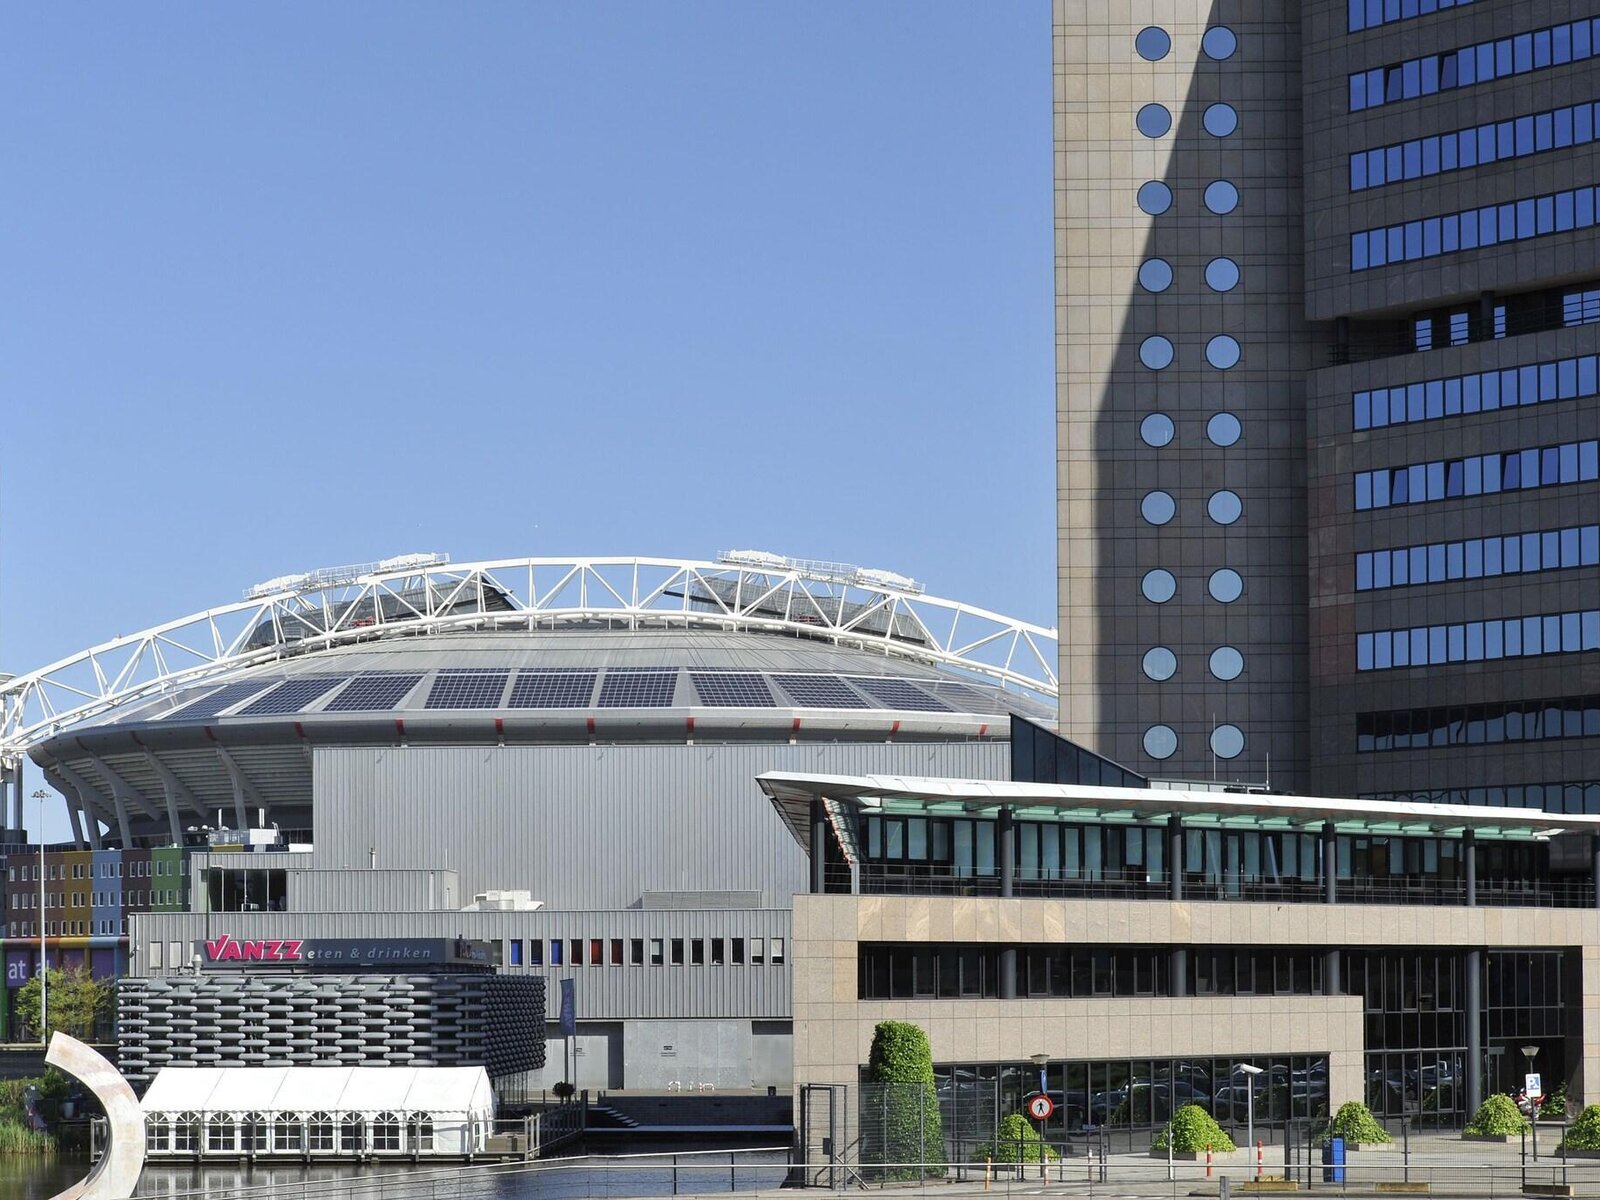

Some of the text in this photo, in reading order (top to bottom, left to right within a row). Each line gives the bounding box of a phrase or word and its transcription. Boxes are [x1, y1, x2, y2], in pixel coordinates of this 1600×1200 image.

[205, 933, 431, 960] VANZZ eten & drinken
[8, 959, 26, 979] at
